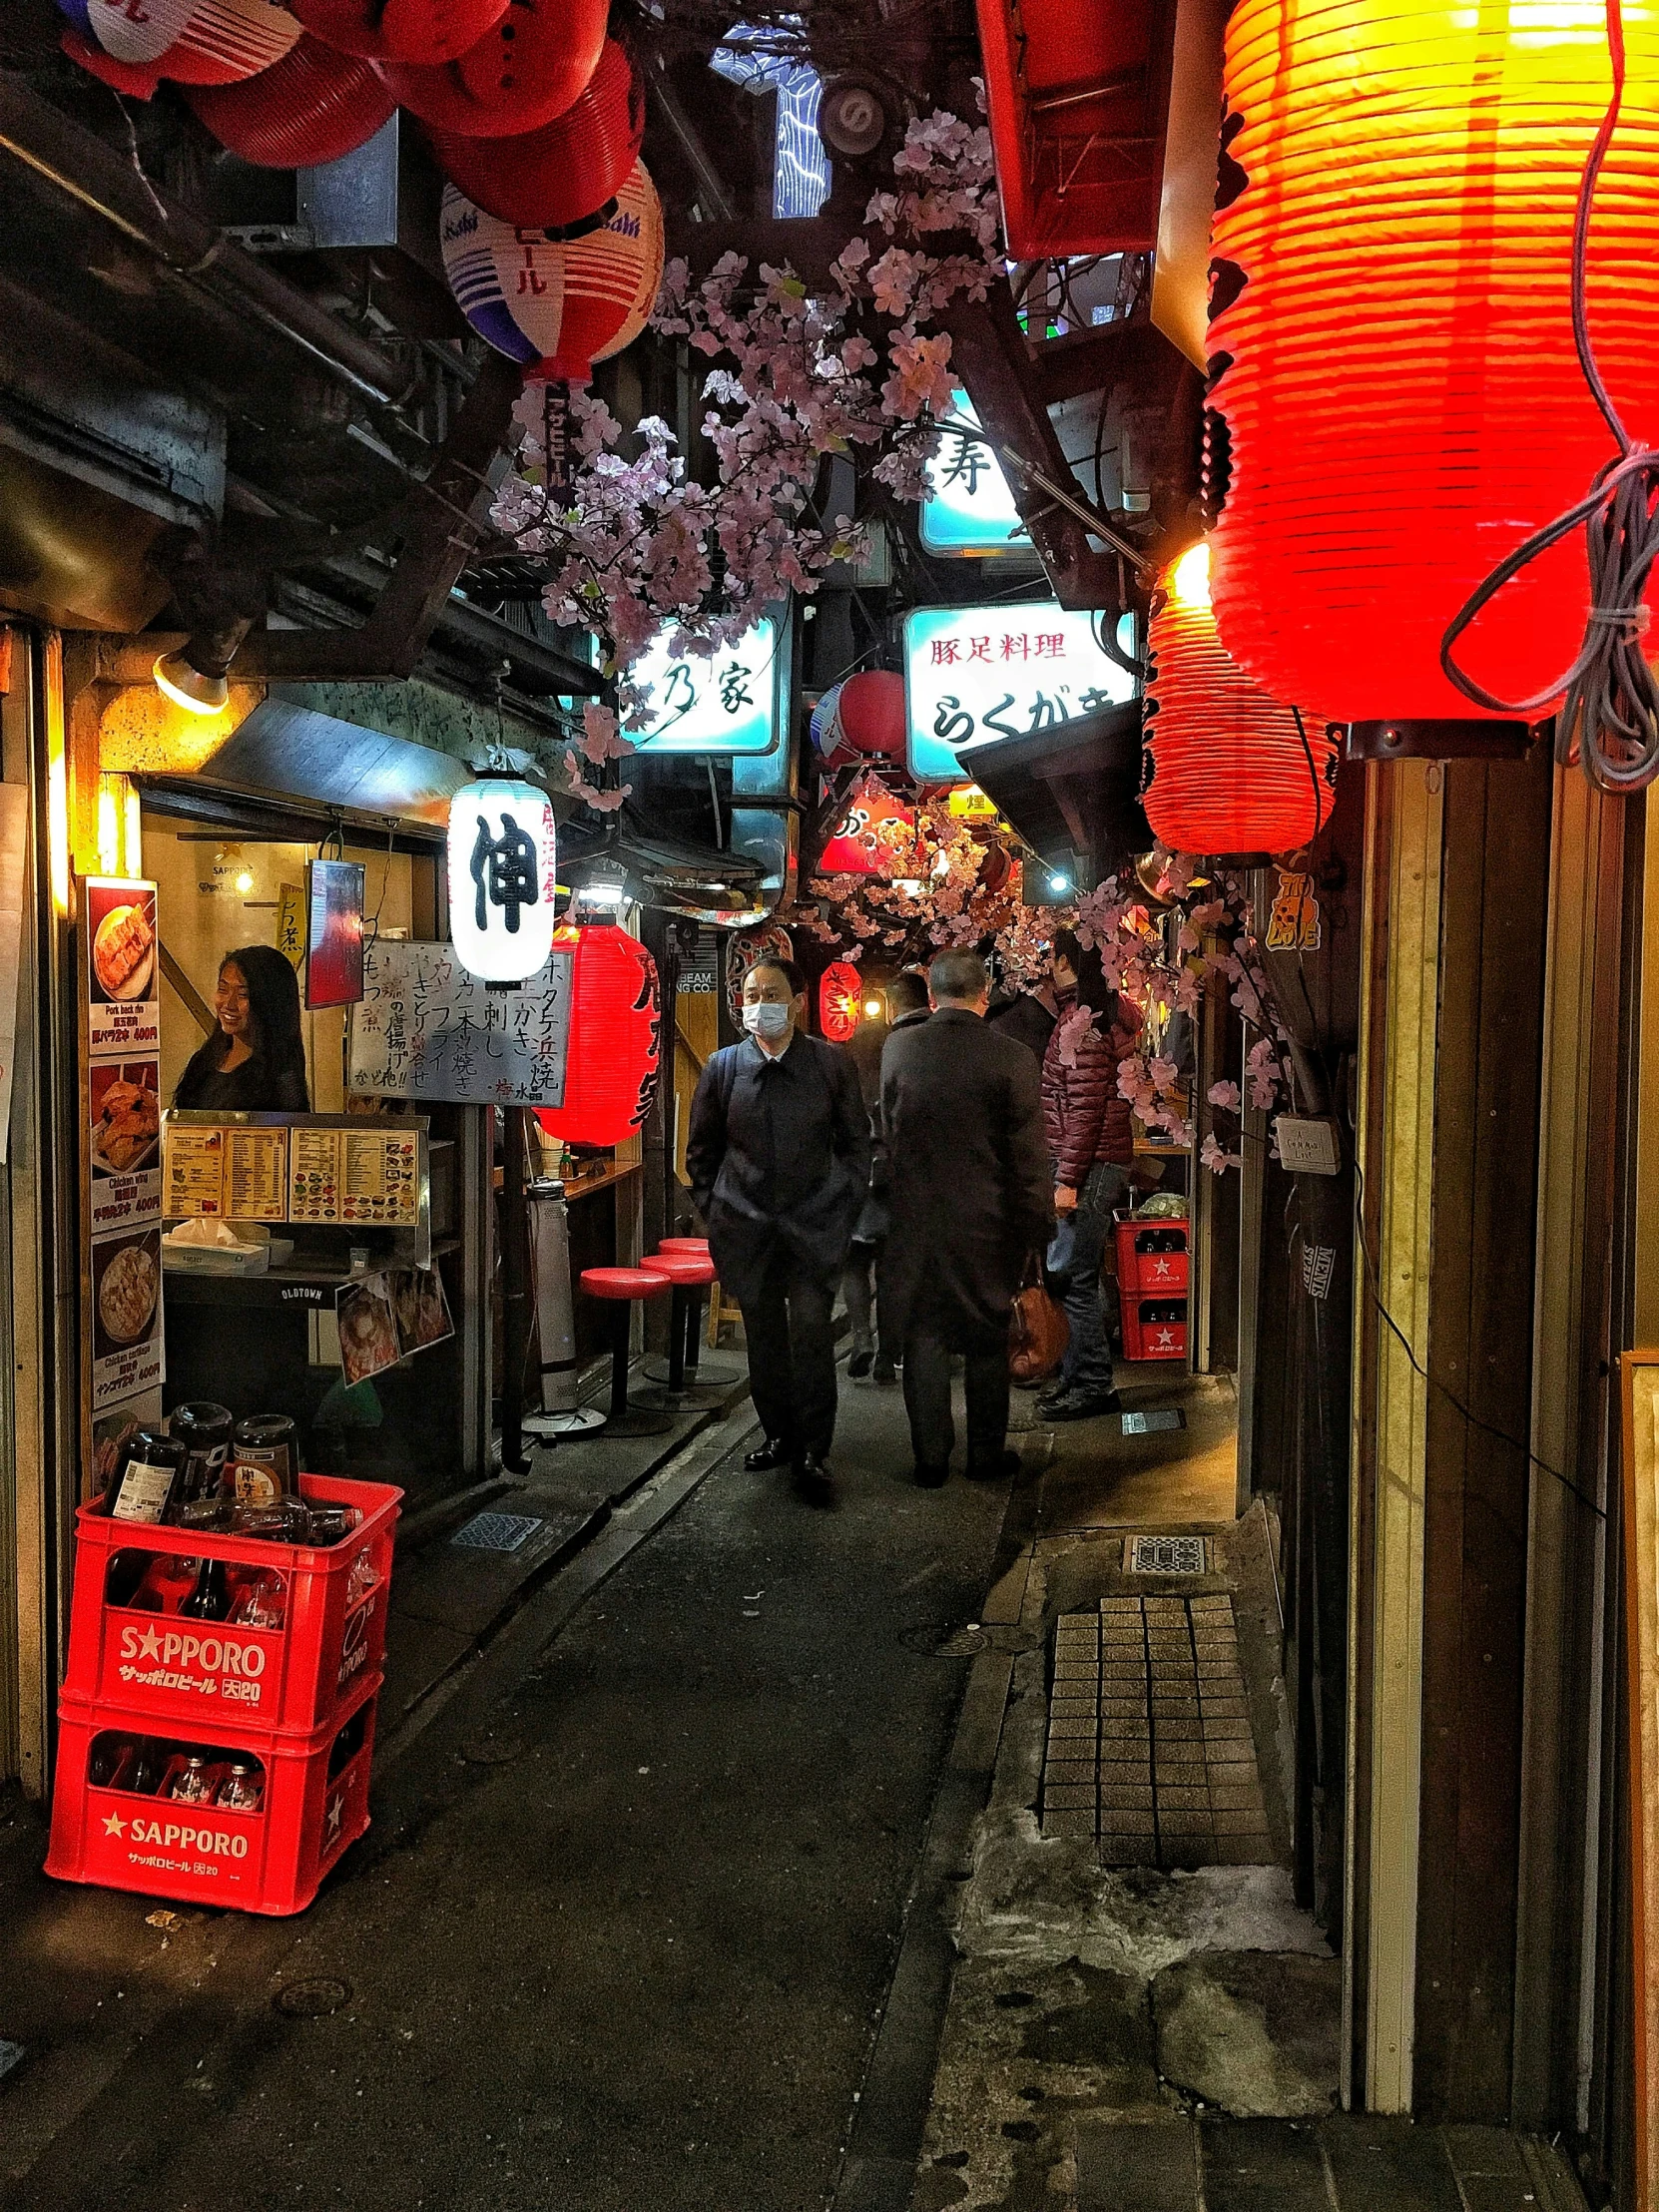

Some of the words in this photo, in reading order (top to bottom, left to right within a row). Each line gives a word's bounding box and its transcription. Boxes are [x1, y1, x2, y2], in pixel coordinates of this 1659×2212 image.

[930, 632, 1067, 666] 豚足料理
[134, 1025, 158, 1041] 400円
[109, 1176, 134, 1189] Chicken
[135, 1194, 160, 1213] 400円
[281, 1288, 322, 1301] OLDTOWN
[138, 1362, 161, 1381] 400円
[119, 1664, 218, 1695] サッポロビール
[130, 1818, 249, 1859] SAPPORO
[128, 1852, 192, 1873] サッポロビール
